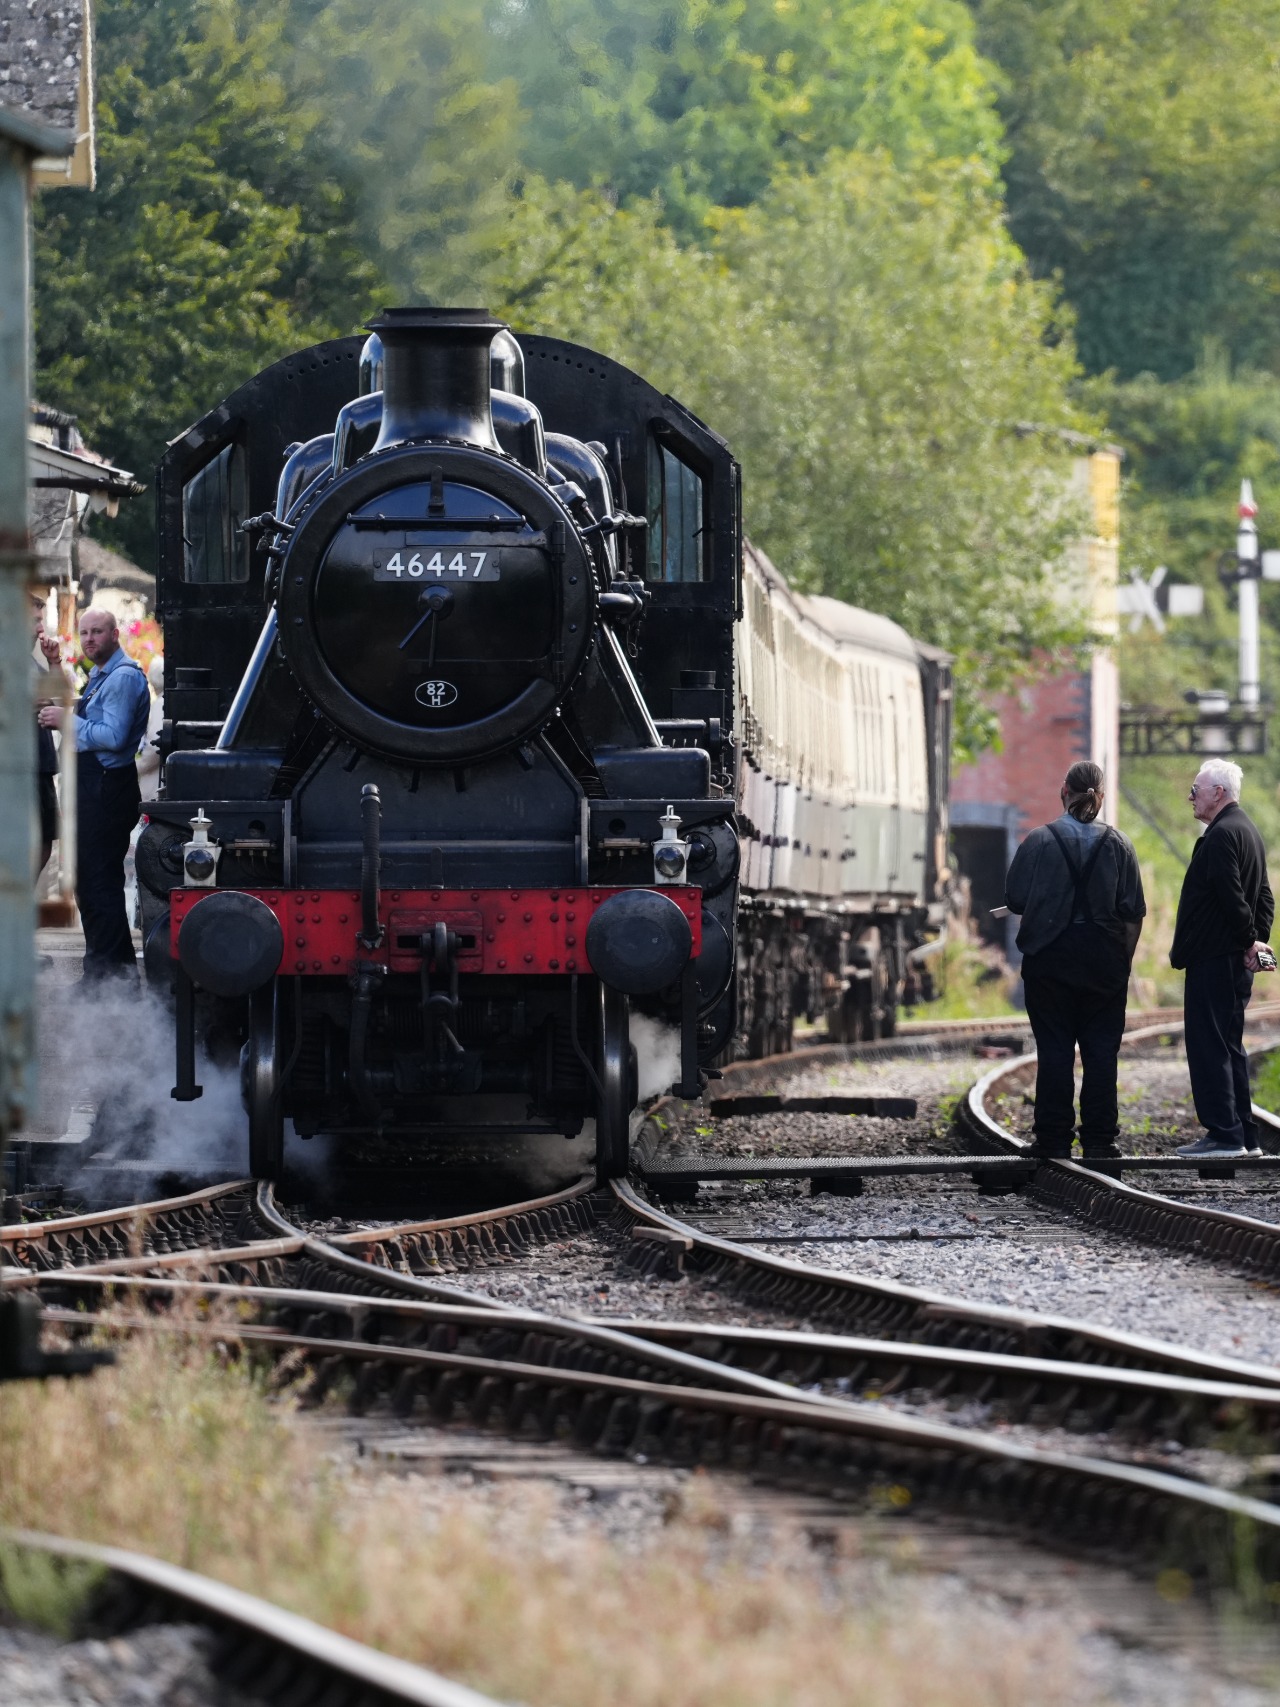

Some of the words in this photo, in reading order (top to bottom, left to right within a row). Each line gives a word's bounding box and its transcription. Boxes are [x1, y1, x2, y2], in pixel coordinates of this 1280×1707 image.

[386, 552, 487, 577] 46447
[426, 682, 446, 696] 82
[431, 695, 441, 706] H
